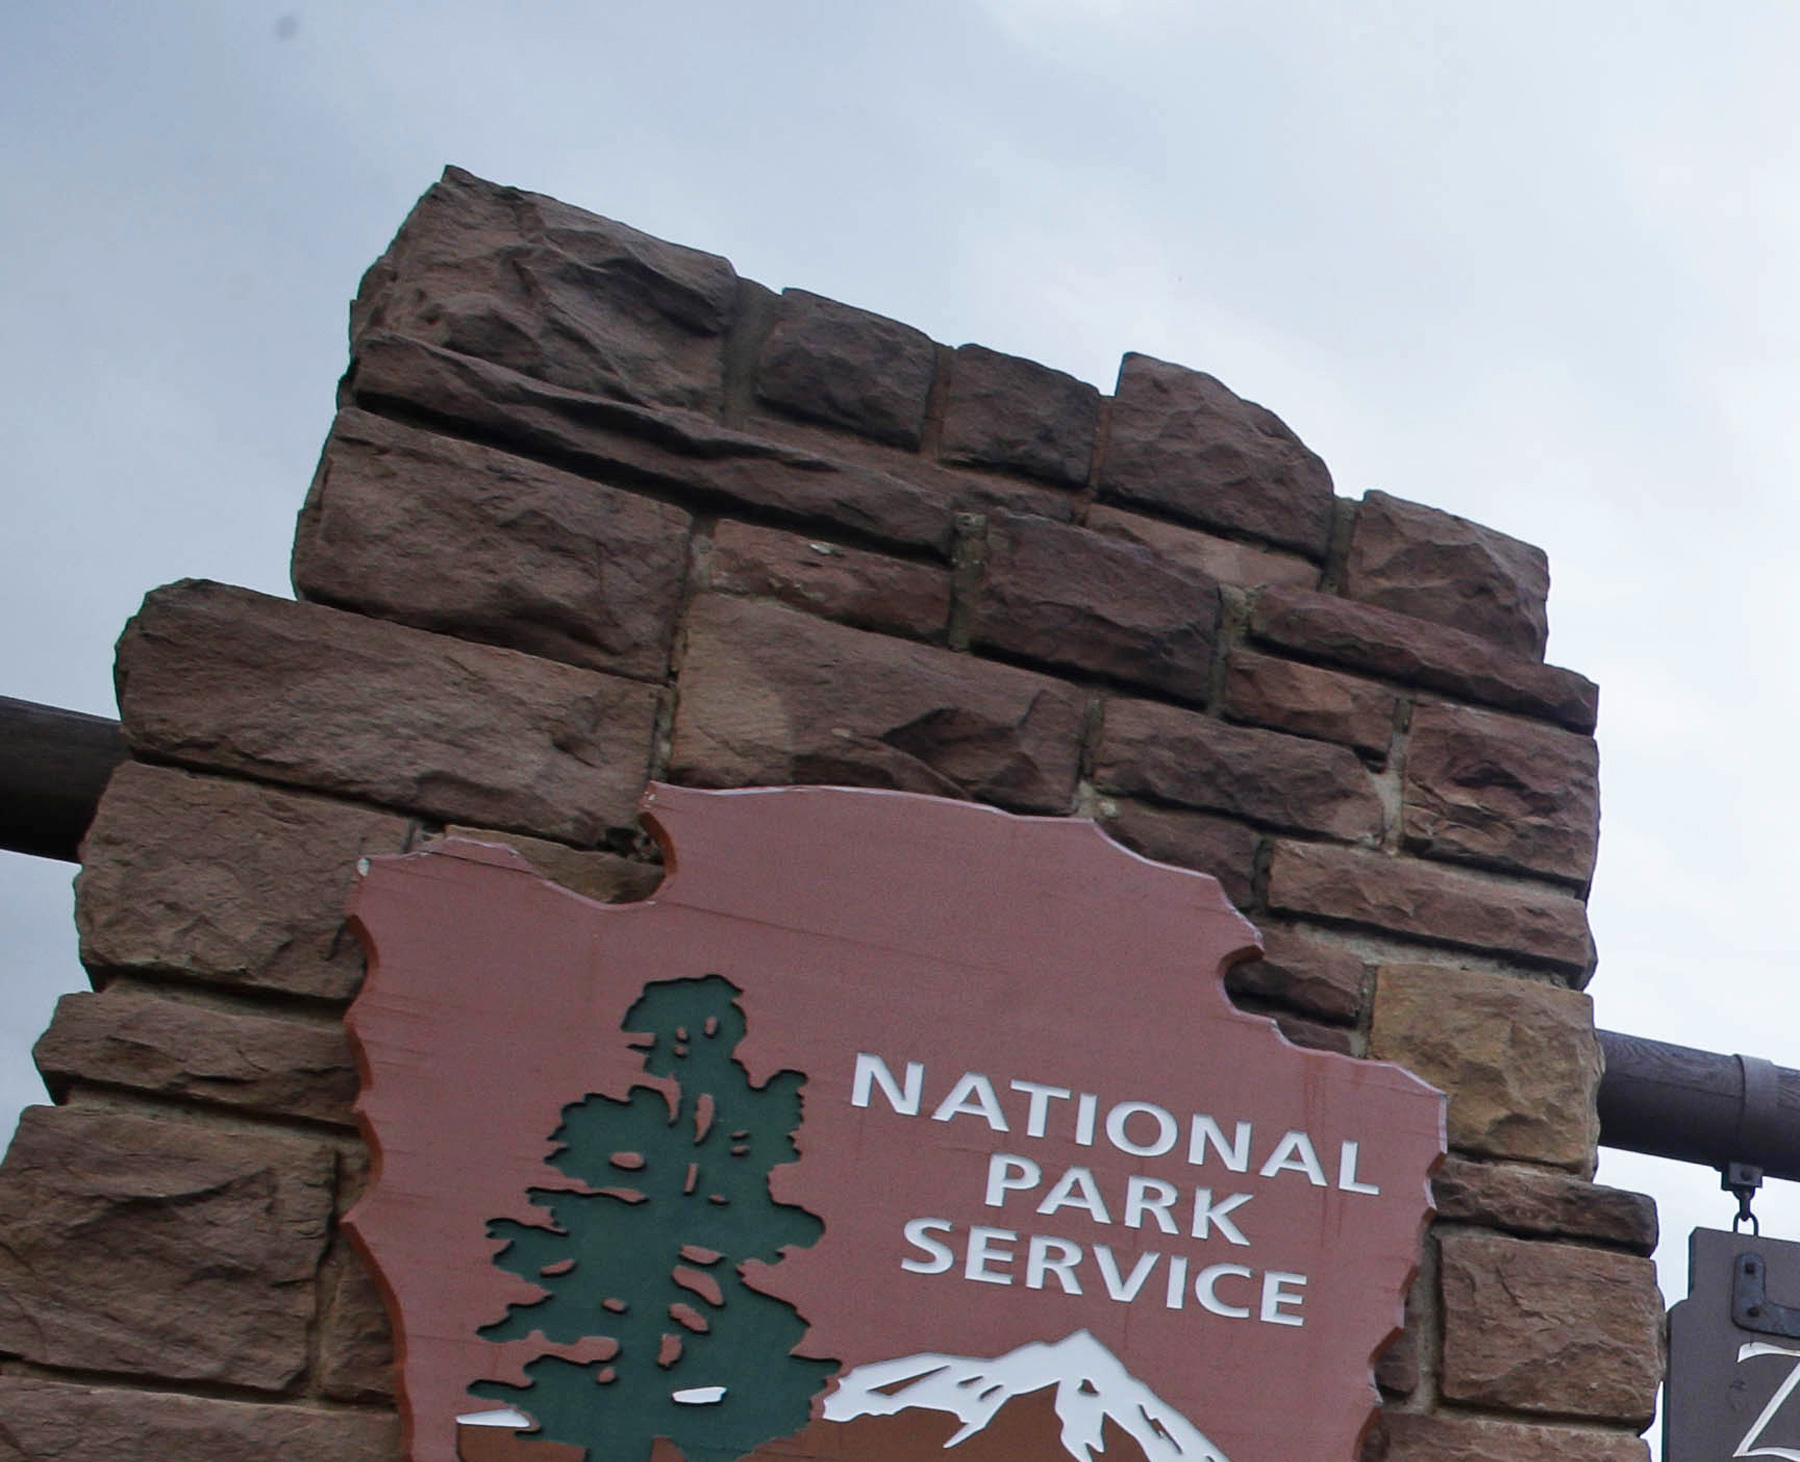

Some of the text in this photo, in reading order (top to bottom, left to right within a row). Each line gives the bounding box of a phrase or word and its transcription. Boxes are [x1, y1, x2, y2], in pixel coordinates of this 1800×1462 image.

[851, 1054, 1379, 1195] NATIONAL
[985, 1155, 1253, 1246] PARK
[901, 1220, 1307, 1326] SERVICE
